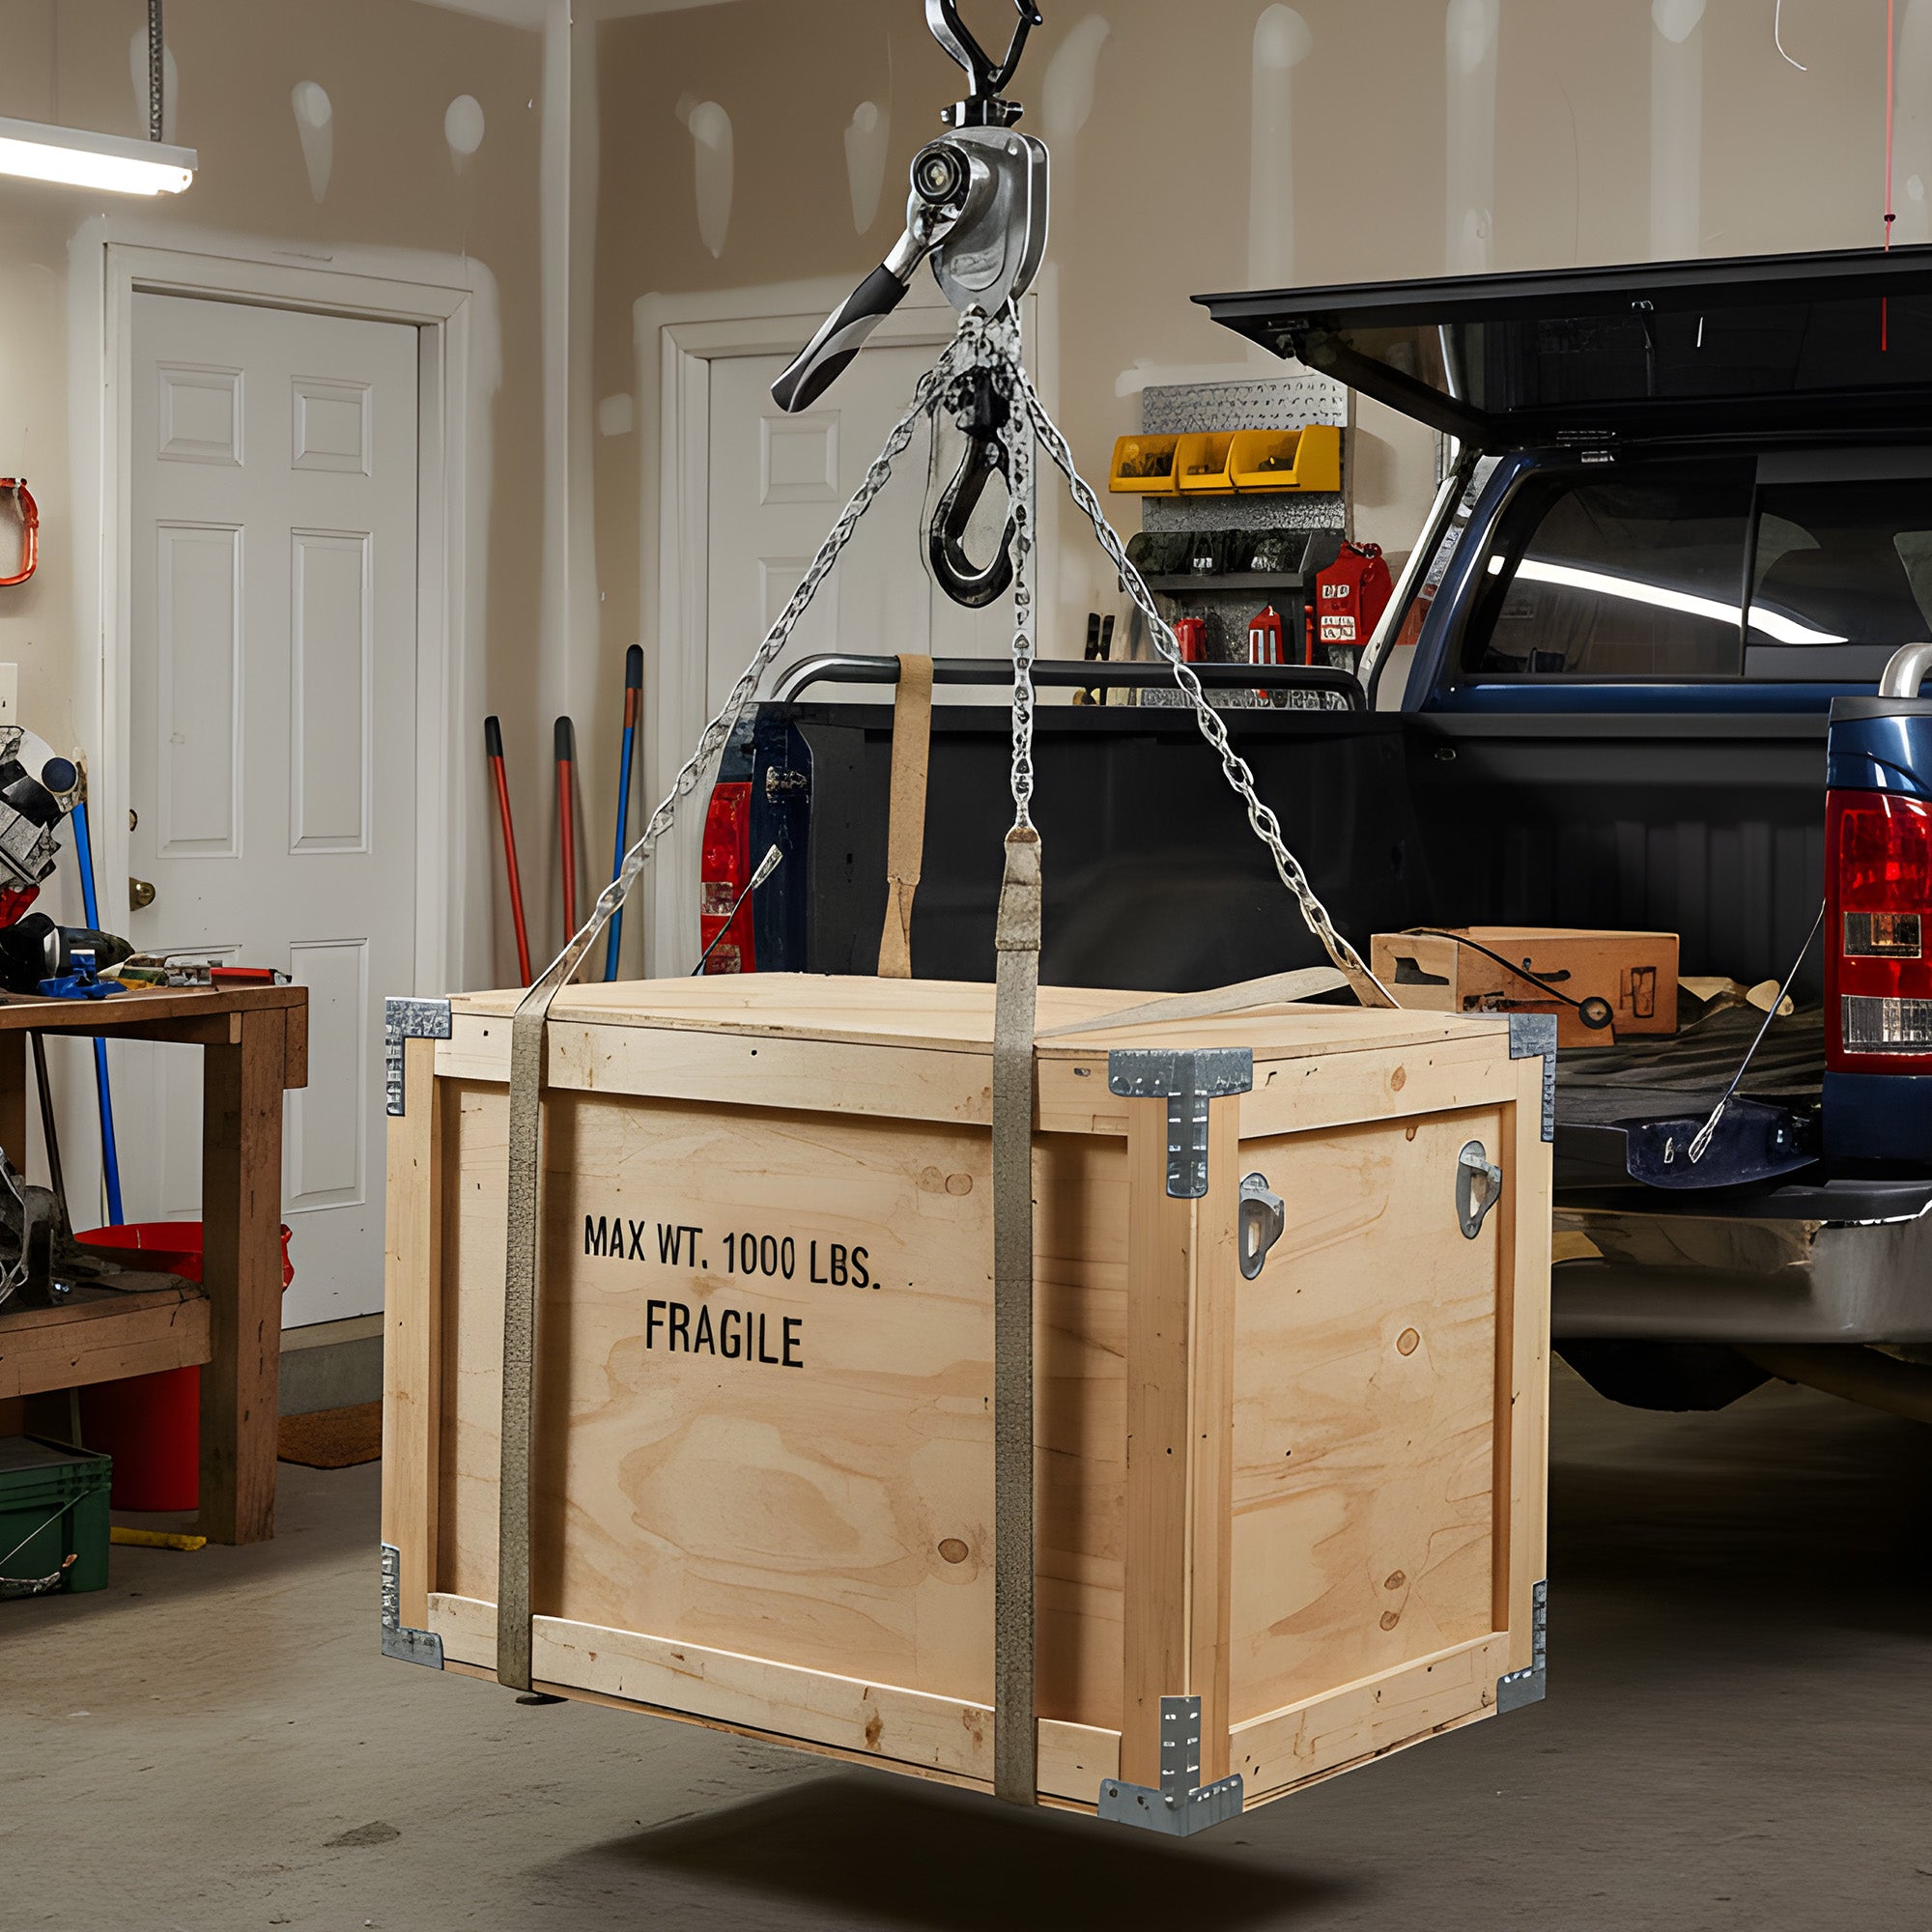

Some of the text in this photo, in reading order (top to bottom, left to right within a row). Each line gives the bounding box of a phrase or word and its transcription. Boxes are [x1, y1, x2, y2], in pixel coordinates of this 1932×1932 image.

[584, 1214, 881, 1291] MAX WT. 1000 LBS.
[646, 1299, 804, 1369] FRAGILE
